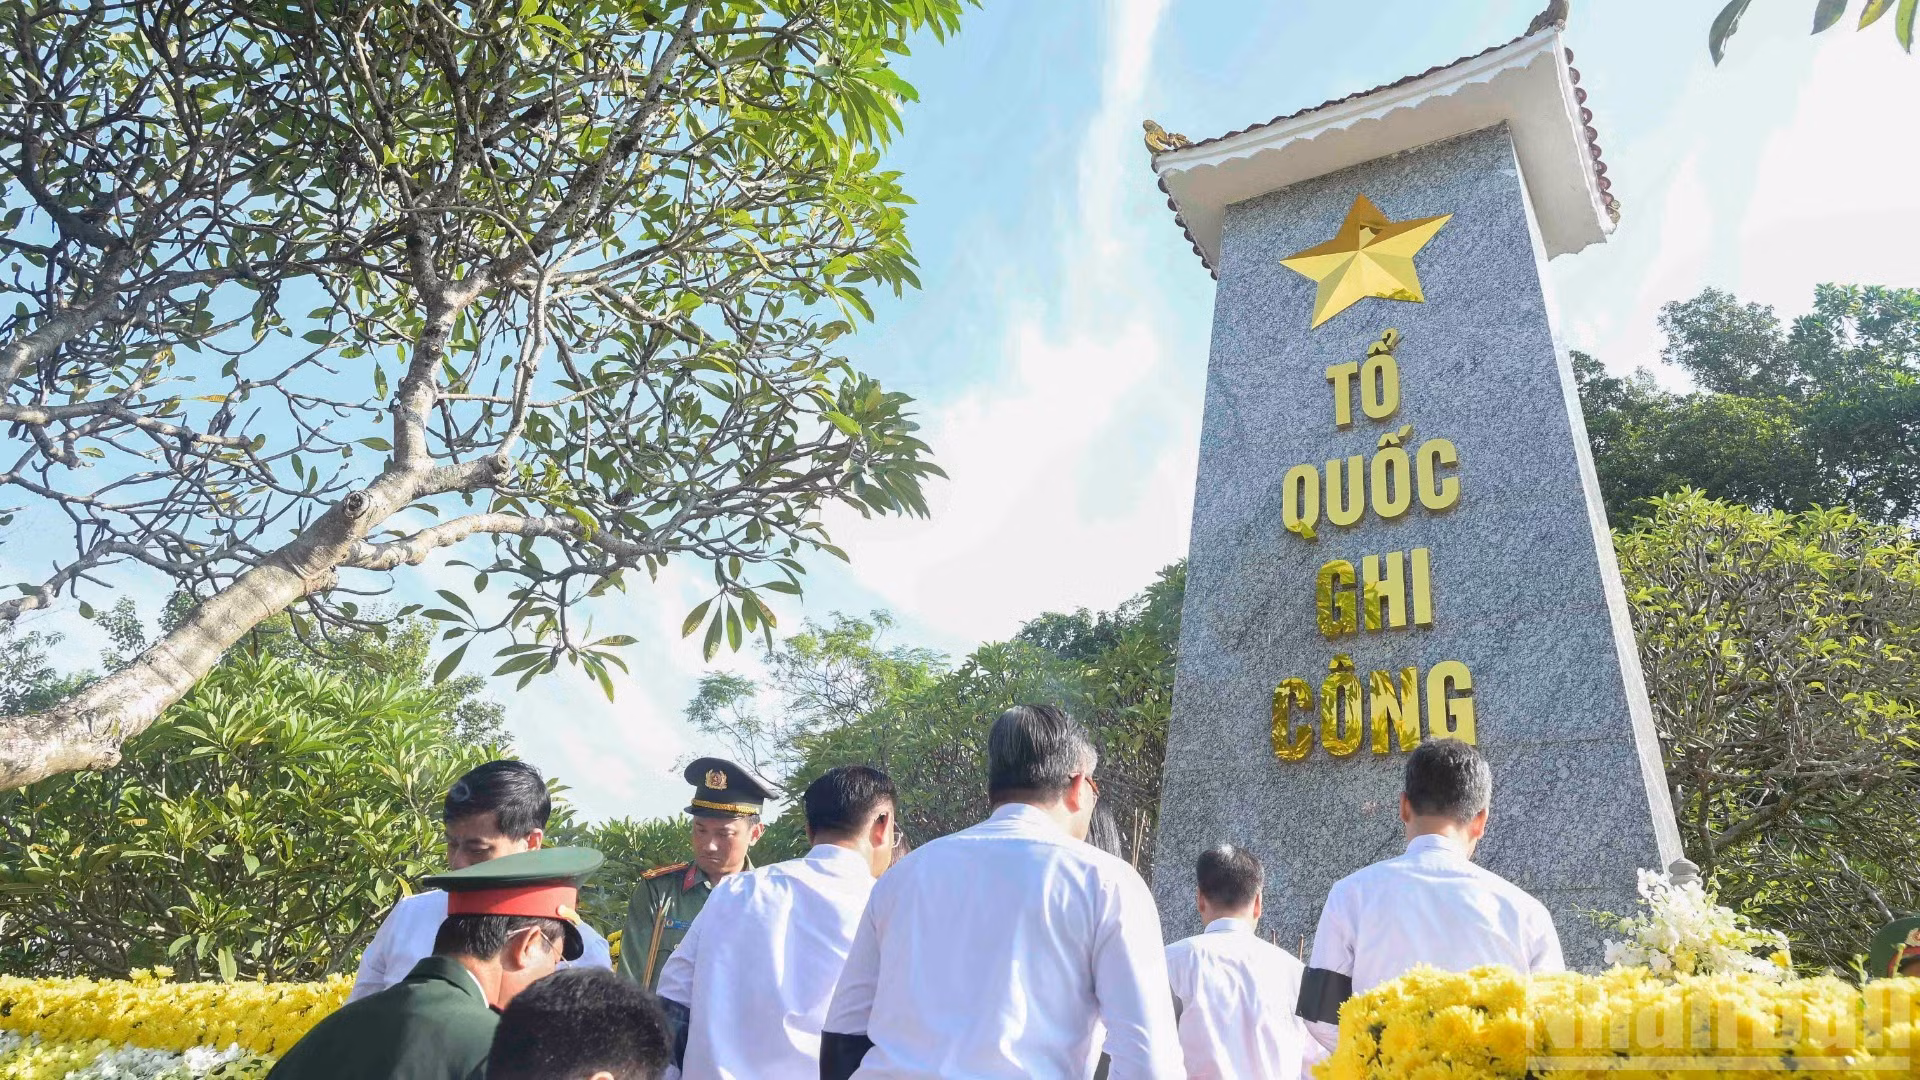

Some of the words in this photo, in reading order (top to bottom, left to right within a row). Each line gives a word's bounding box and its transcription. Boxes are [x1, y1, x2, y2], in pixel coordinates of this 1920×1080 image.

[1326, 328, 1403, 427] TỔ
[1282, 424, 1460, 541] QUỐC
[1315, 547, 1433, 639] GHI
[1271, 653, 1477, 763] CÔNG
